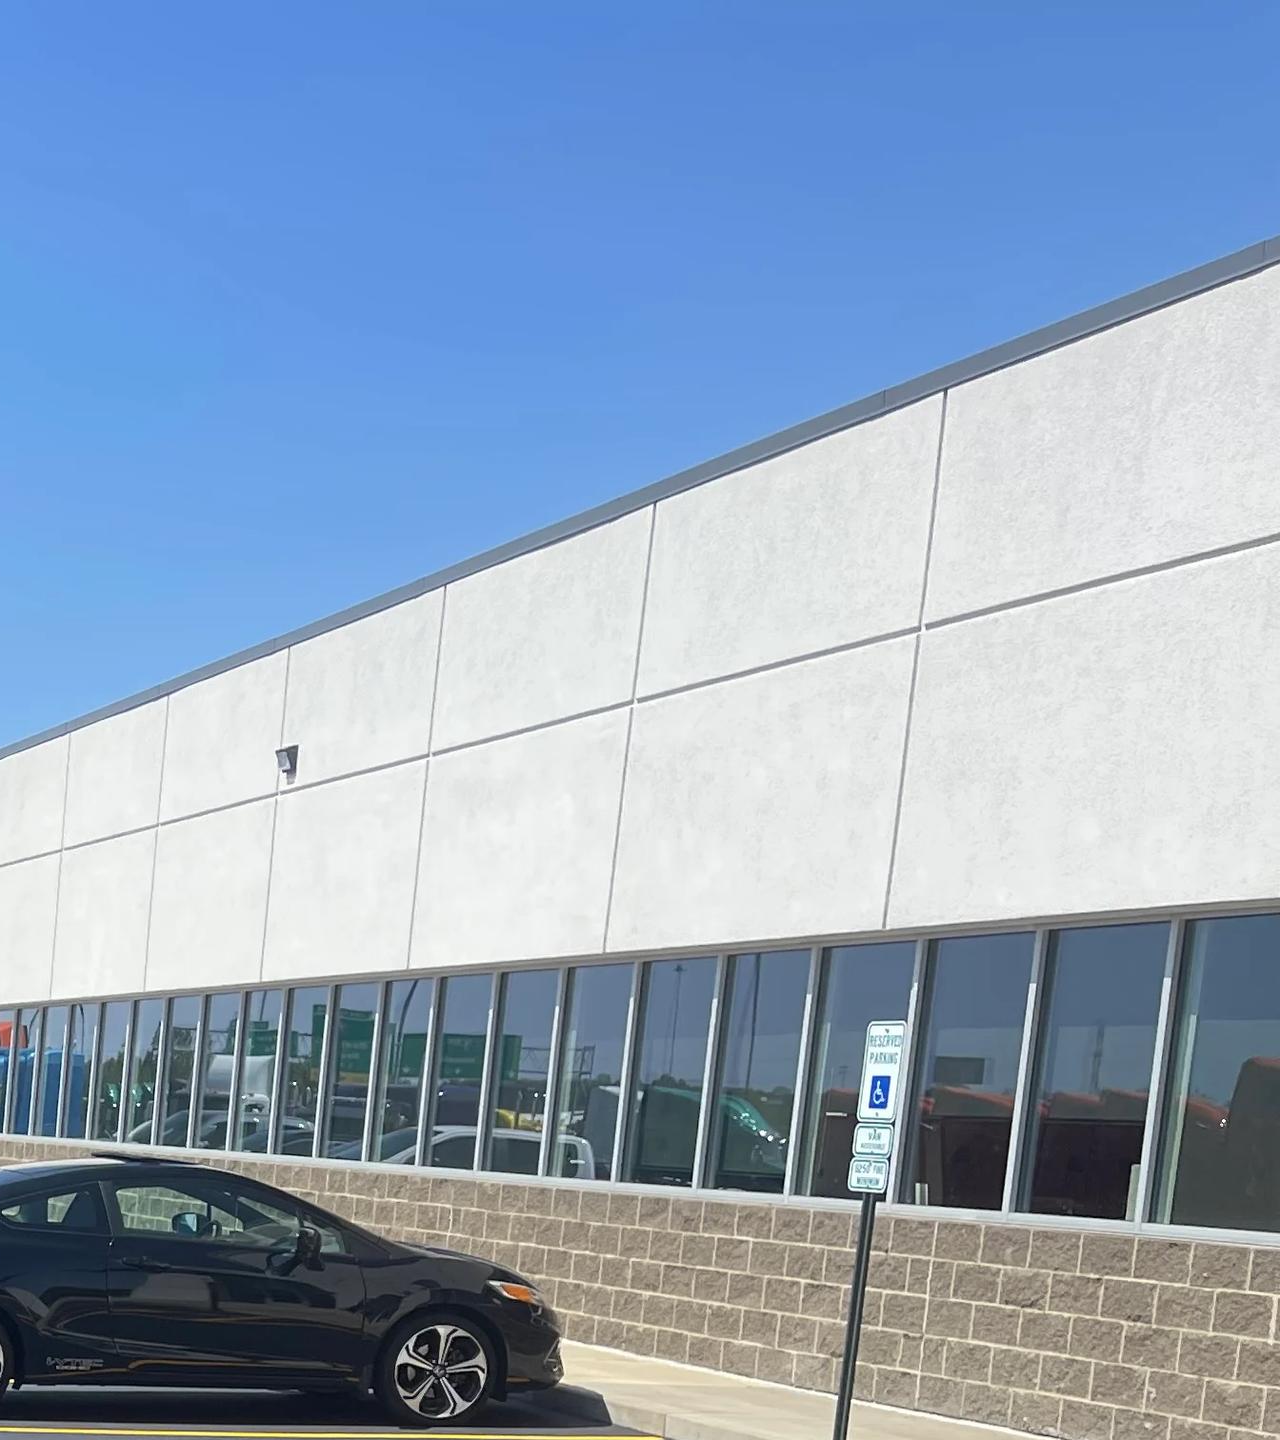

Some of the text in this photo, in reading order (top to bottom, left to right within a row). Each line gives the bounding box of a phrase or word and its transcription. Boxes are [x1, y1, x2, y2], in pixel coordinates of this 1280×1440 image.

[870, 1035, 903, 1047] RESERVED
[870, 1052, 898, 1064] PARKING
[868, 1133, 881, 1141] VAN
